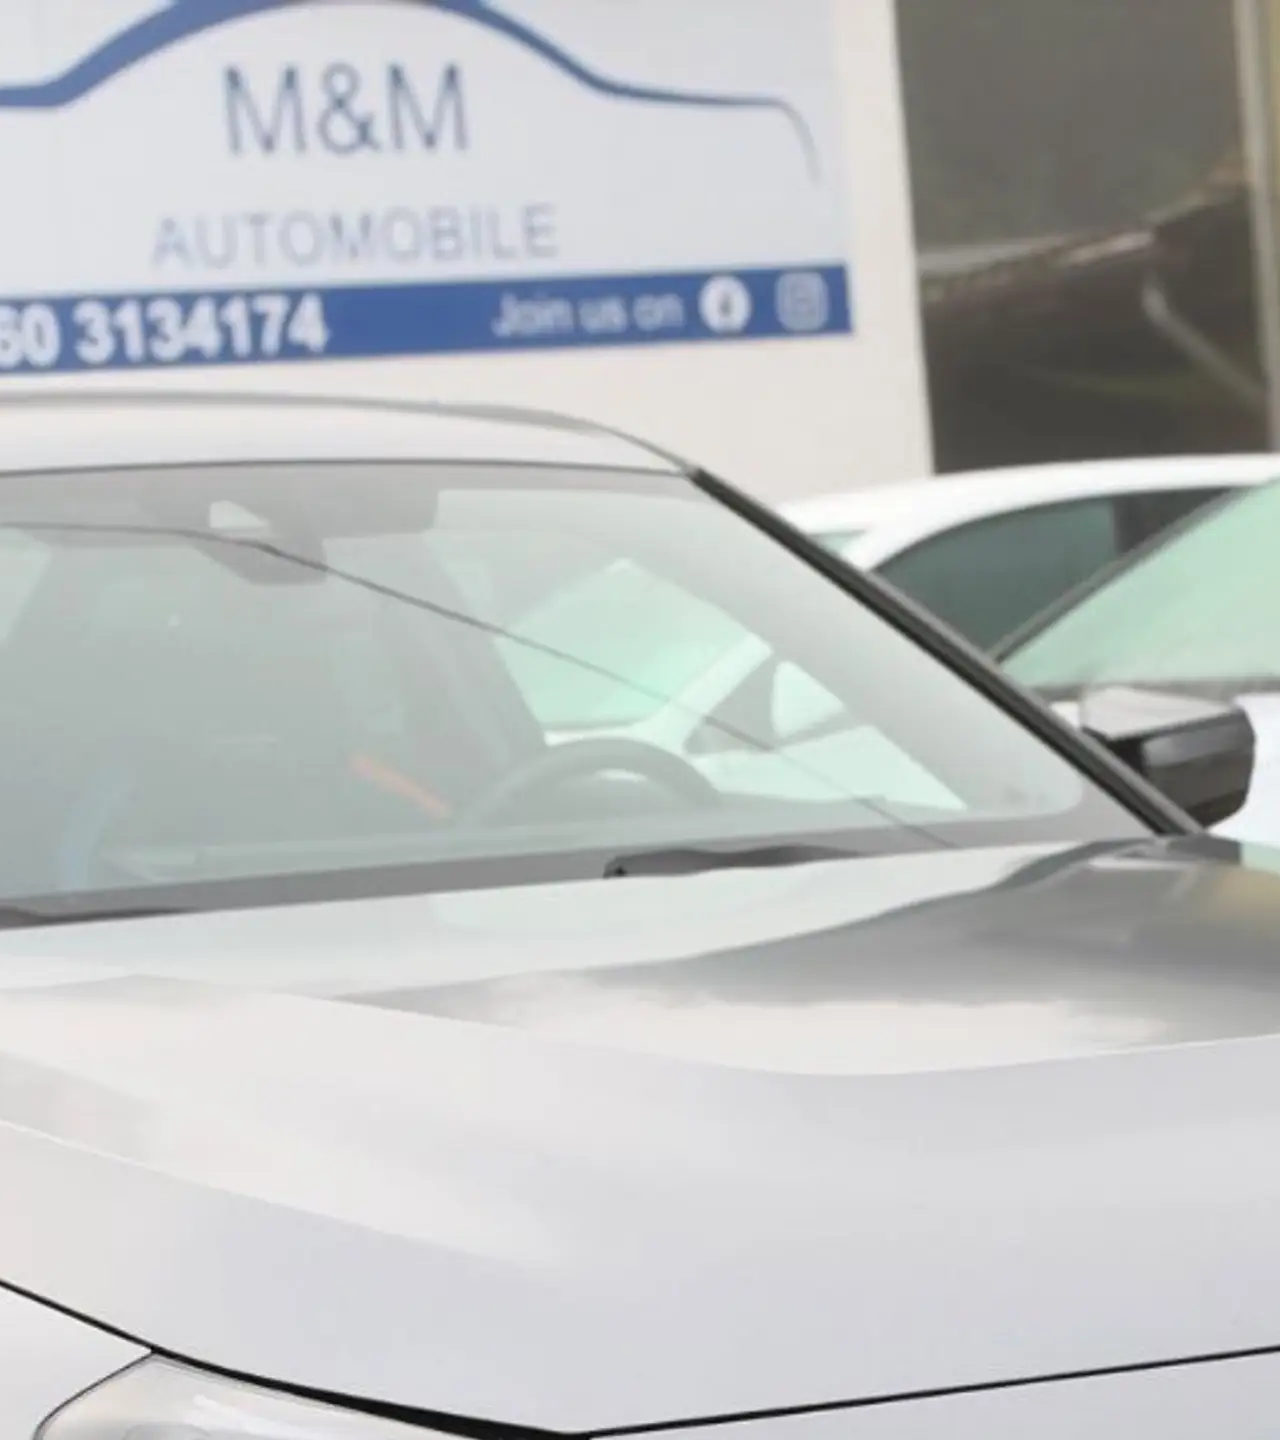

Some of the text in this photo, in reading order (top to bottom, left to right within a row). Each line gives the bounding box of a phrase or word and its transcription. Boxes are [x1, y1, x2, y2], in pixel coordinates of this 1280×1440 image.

[224, 62, 469, 155] M&M
[152, 202, 560, 268] AUTOMOBILE
[74, 291, 329, 362] 3134174
[492, 292, 683, 337] Join us on
